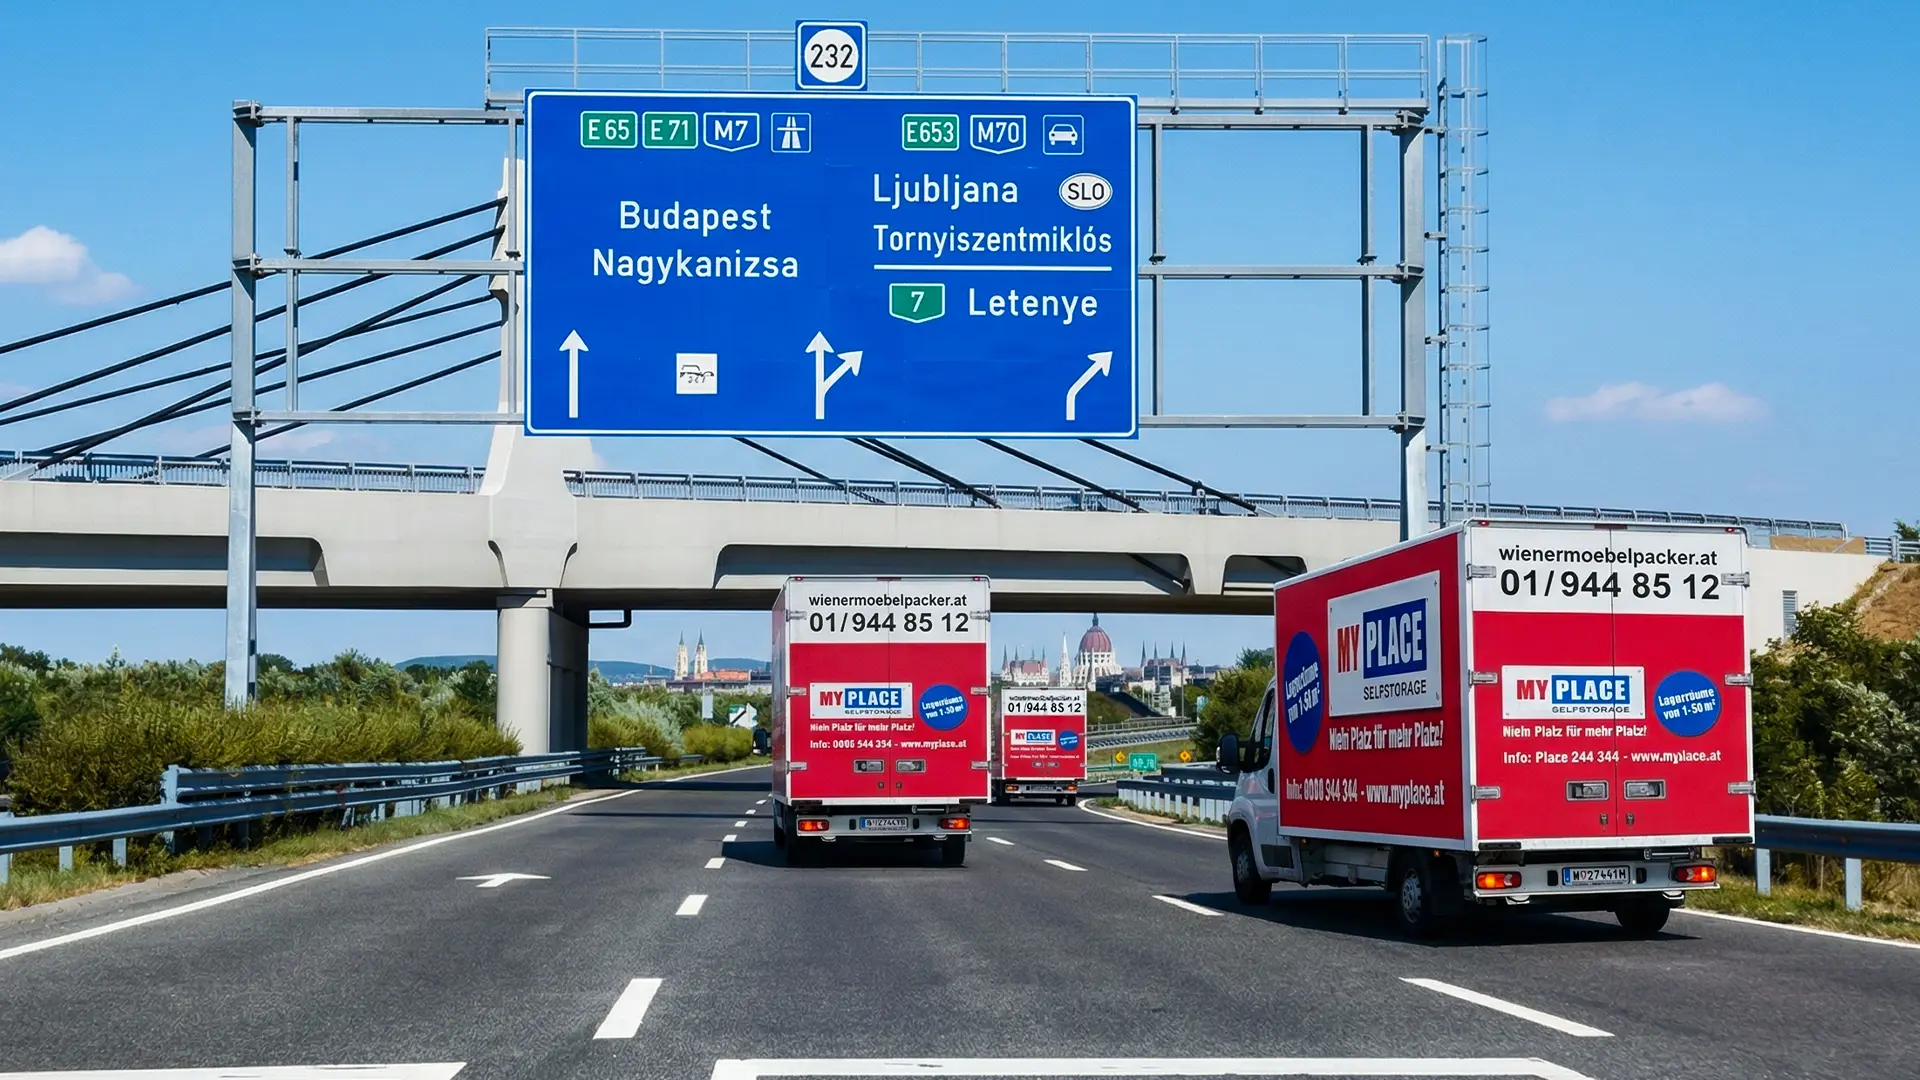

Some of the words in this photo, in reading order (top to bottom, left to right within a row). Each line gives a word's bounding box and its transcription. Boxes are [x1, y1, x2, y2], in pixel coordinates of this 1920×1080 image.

[810, 44, 853, 68] 232
[589, 119, 600, 139] E
[606, 119, 629, 140] 65
[651, 120, 663, 140] E
[669, 120, 688, 140] 71
[714, 121, 749, 142] M7
[906, 121, 955, 144] E653
[977, 121, 1020, 144] M70
[874, 174, 1017, 209] Ljubljana
[1067, 181, 1105, 201] SLO
[621, 201, 771, 237] Budapest
[874, 225, 1111, 258] Tornyiszentmiklós
[594, 249, 797, 284] Nagykanizsa
[910, 290, 926, 313] 7
[970, 288, 1097, 324] Letenye
[1499, 545, 1717, 568] wienermoebelpacker.at
[1633, 573, 1670, 598] 85
[1683, 573, 1720, 600] 12
[809, 594, 966, 609] wienermoebelpacker.at
[904, 613, 932, 632] 85
[941, 612, 969, 633] 12
[1338, 624, 1359, 673] MY
[1366, 610, 1423, 669] PLACE
[820, 691, 843, 706] MY
[848, 691, 899, 705] PLACE
[1517, 680, 1548, 700] MY
[1556, 680, 1625, 700] PLACE
[1068, 703, 1081, 712] 12
[1585, 726, 1613, 736] mehr
[810, 740, 830, 748] Info:
[1504, 752, 1531, 763] Info:
[1572, 751, 1594, 762] 244
[1597, 751, 1619, 762] 344
[1366, 780, 1444, 809] www.myplace.at
